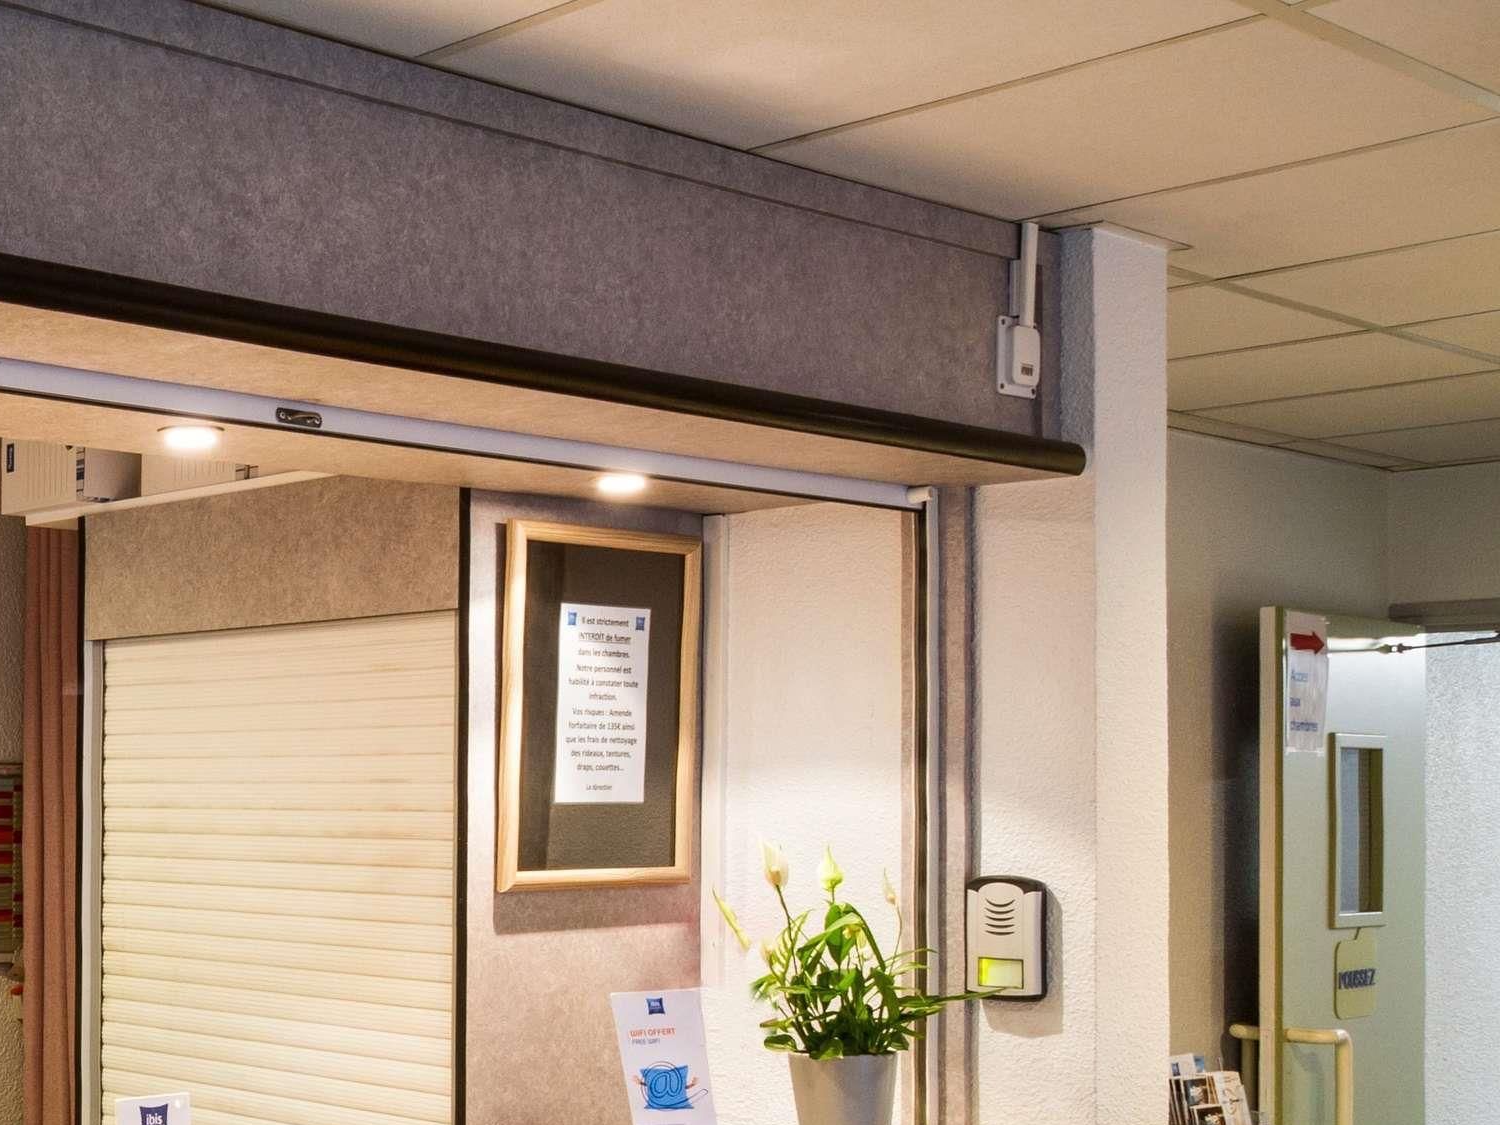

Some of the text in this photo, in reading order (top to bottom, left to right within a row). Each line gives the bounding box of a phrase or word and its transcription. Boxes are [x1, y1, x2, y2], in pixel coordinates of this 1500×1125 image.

[587, 616, 596, 626] est
[597, 616, 629, 627] strictement
[579, 632, 606, 641] INTERDIT
[614, 634, 631, 643] fumer
[593, 647, 601, 656] les
[594, 664, 622, 674] personnel
[623, 666, 632, 674] est
[623, 679, 638, 689] toute
[599, 722, 606, 730] de
[577, 735, 586, 744] les
[587, 735, 599, 744] frais
[600, 735, 608, 744] de
[609, 736, 637, 747] nettoyage
[571, 749, 581, 758] des
[1338, 968, 1376, 990] POUSSEZ
[647, 1026, 676, 1037] OFFERT
[146, 1112, 163, 1125] ibis
